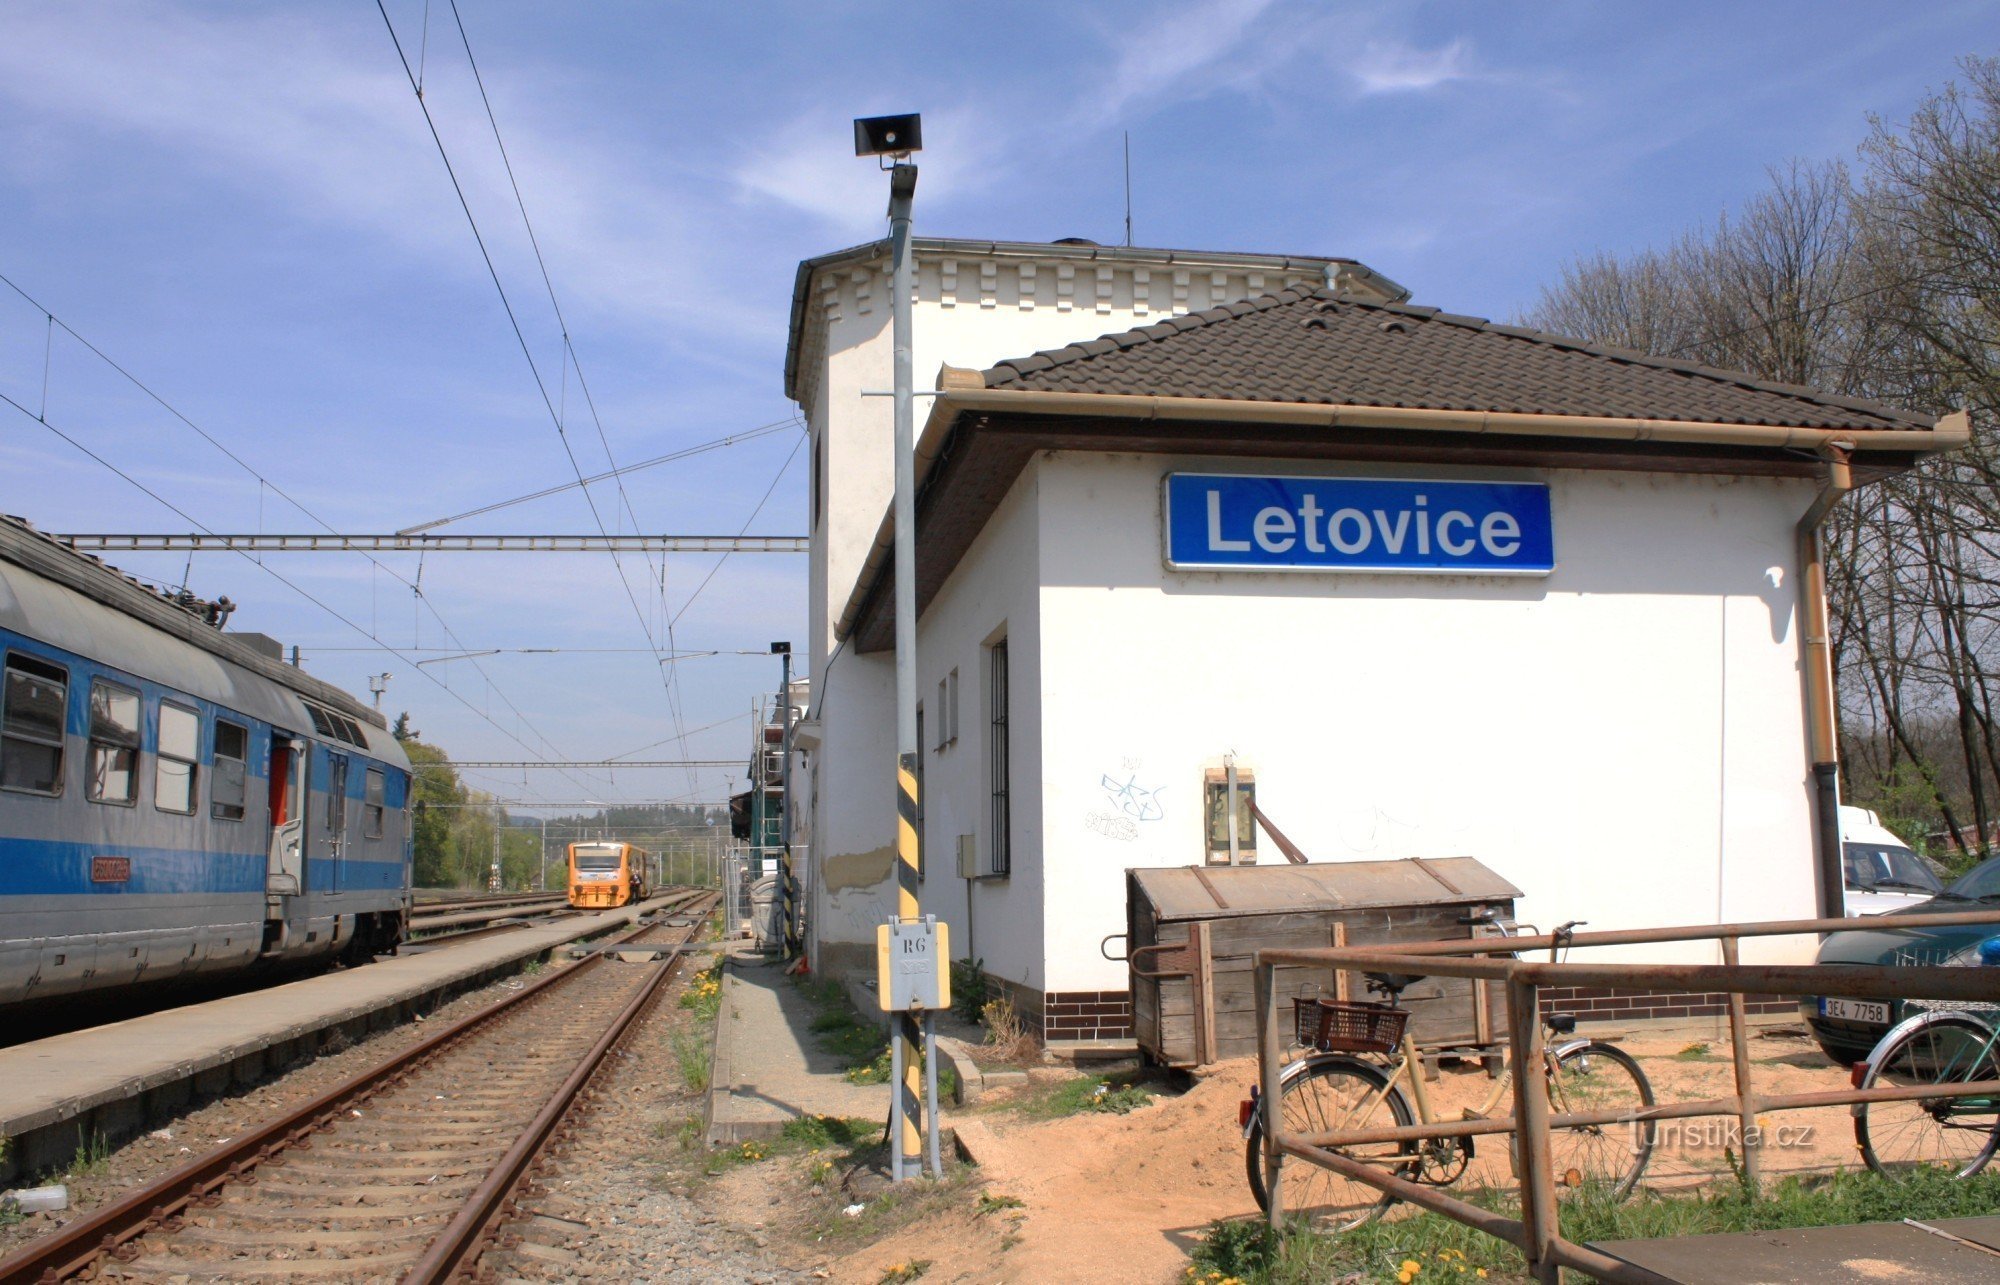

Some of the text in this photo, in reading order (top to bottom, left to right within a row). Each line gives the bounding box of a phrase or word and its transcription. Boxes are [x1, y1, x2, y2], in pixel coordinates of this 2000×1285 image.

[1206, 490, 1521, 557] Letovice
[903, 937, 926, 954] R6
[1827, 1000, 1883, 1021] 3E4 7758
